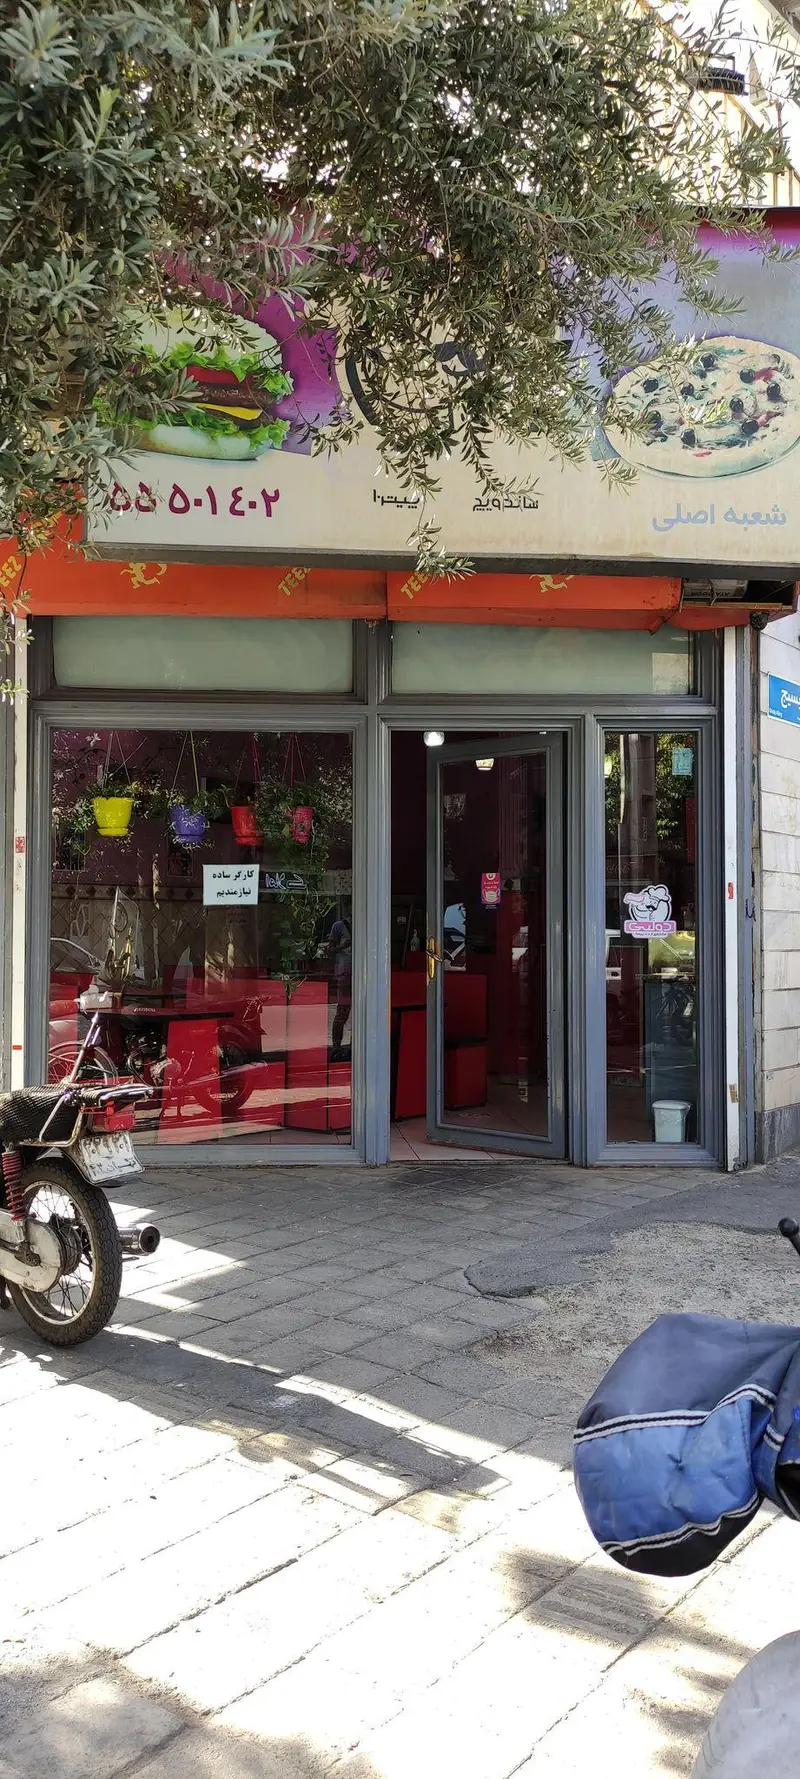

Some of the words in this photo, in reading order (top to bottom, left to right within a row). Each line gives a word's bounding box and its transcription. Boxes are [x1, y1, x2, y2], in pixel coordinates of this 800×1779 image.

[373, 488, 421, 509] پیتزا
[473, 495, 539, 512] ساندویچ
[652, 502, 716, 532] اصلی
[724, 503, 788, 532] شعبه
[0, 555, 22, 587] EEZ
[400, 572, 429, 600] TEE
[212, 870, 231, 879] ساده
[233, 870, 255, 881] کارگر
[216, 887, 252, 899] نیازمندیم
[106, 1157, 137, 1173] تهران
